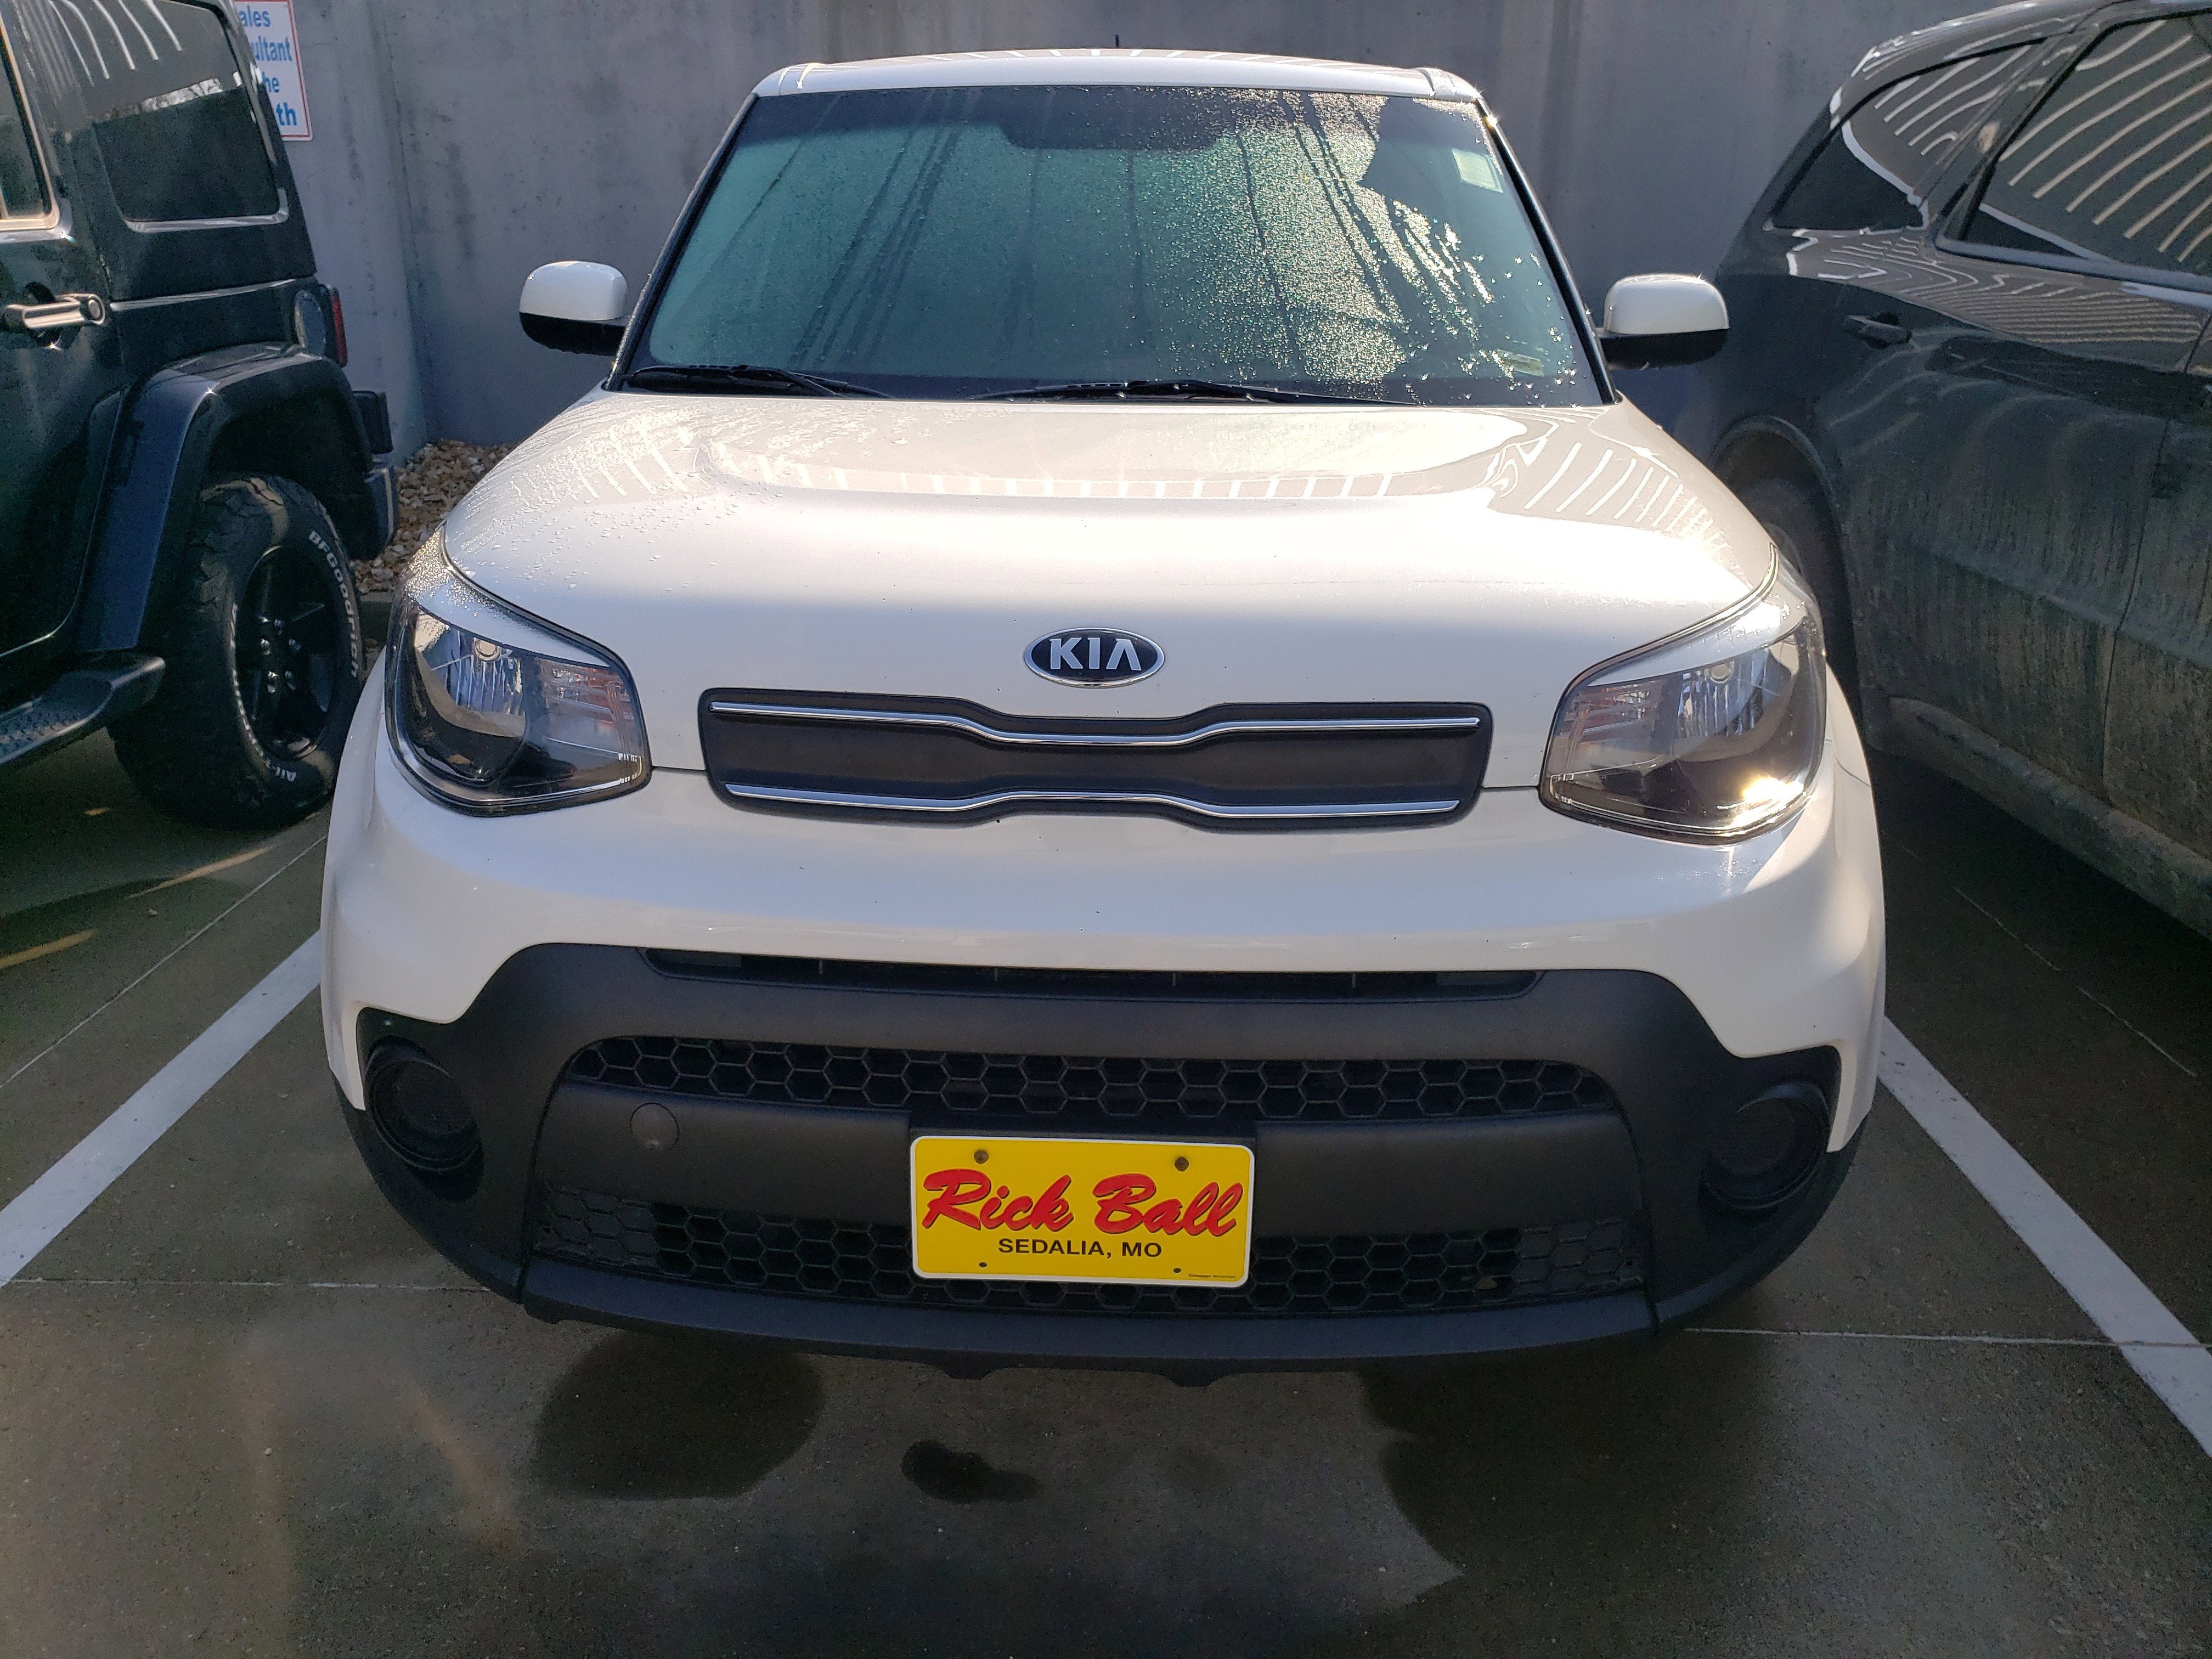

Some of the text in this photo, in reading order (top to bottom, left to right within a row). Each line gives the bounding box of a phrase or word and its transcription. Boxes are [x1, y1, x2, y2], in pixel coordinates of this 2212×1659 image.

[239, 5, 271, 27] ales
[251, 36, 292, 61] ultant
[262, 71, 280, 93] he
[1049, 637, 1142, 671] KIA
[922, 1168, 1244, 1237] Rick Ball
[998, 1238, 1162, 1259] SEDALIA, MO
